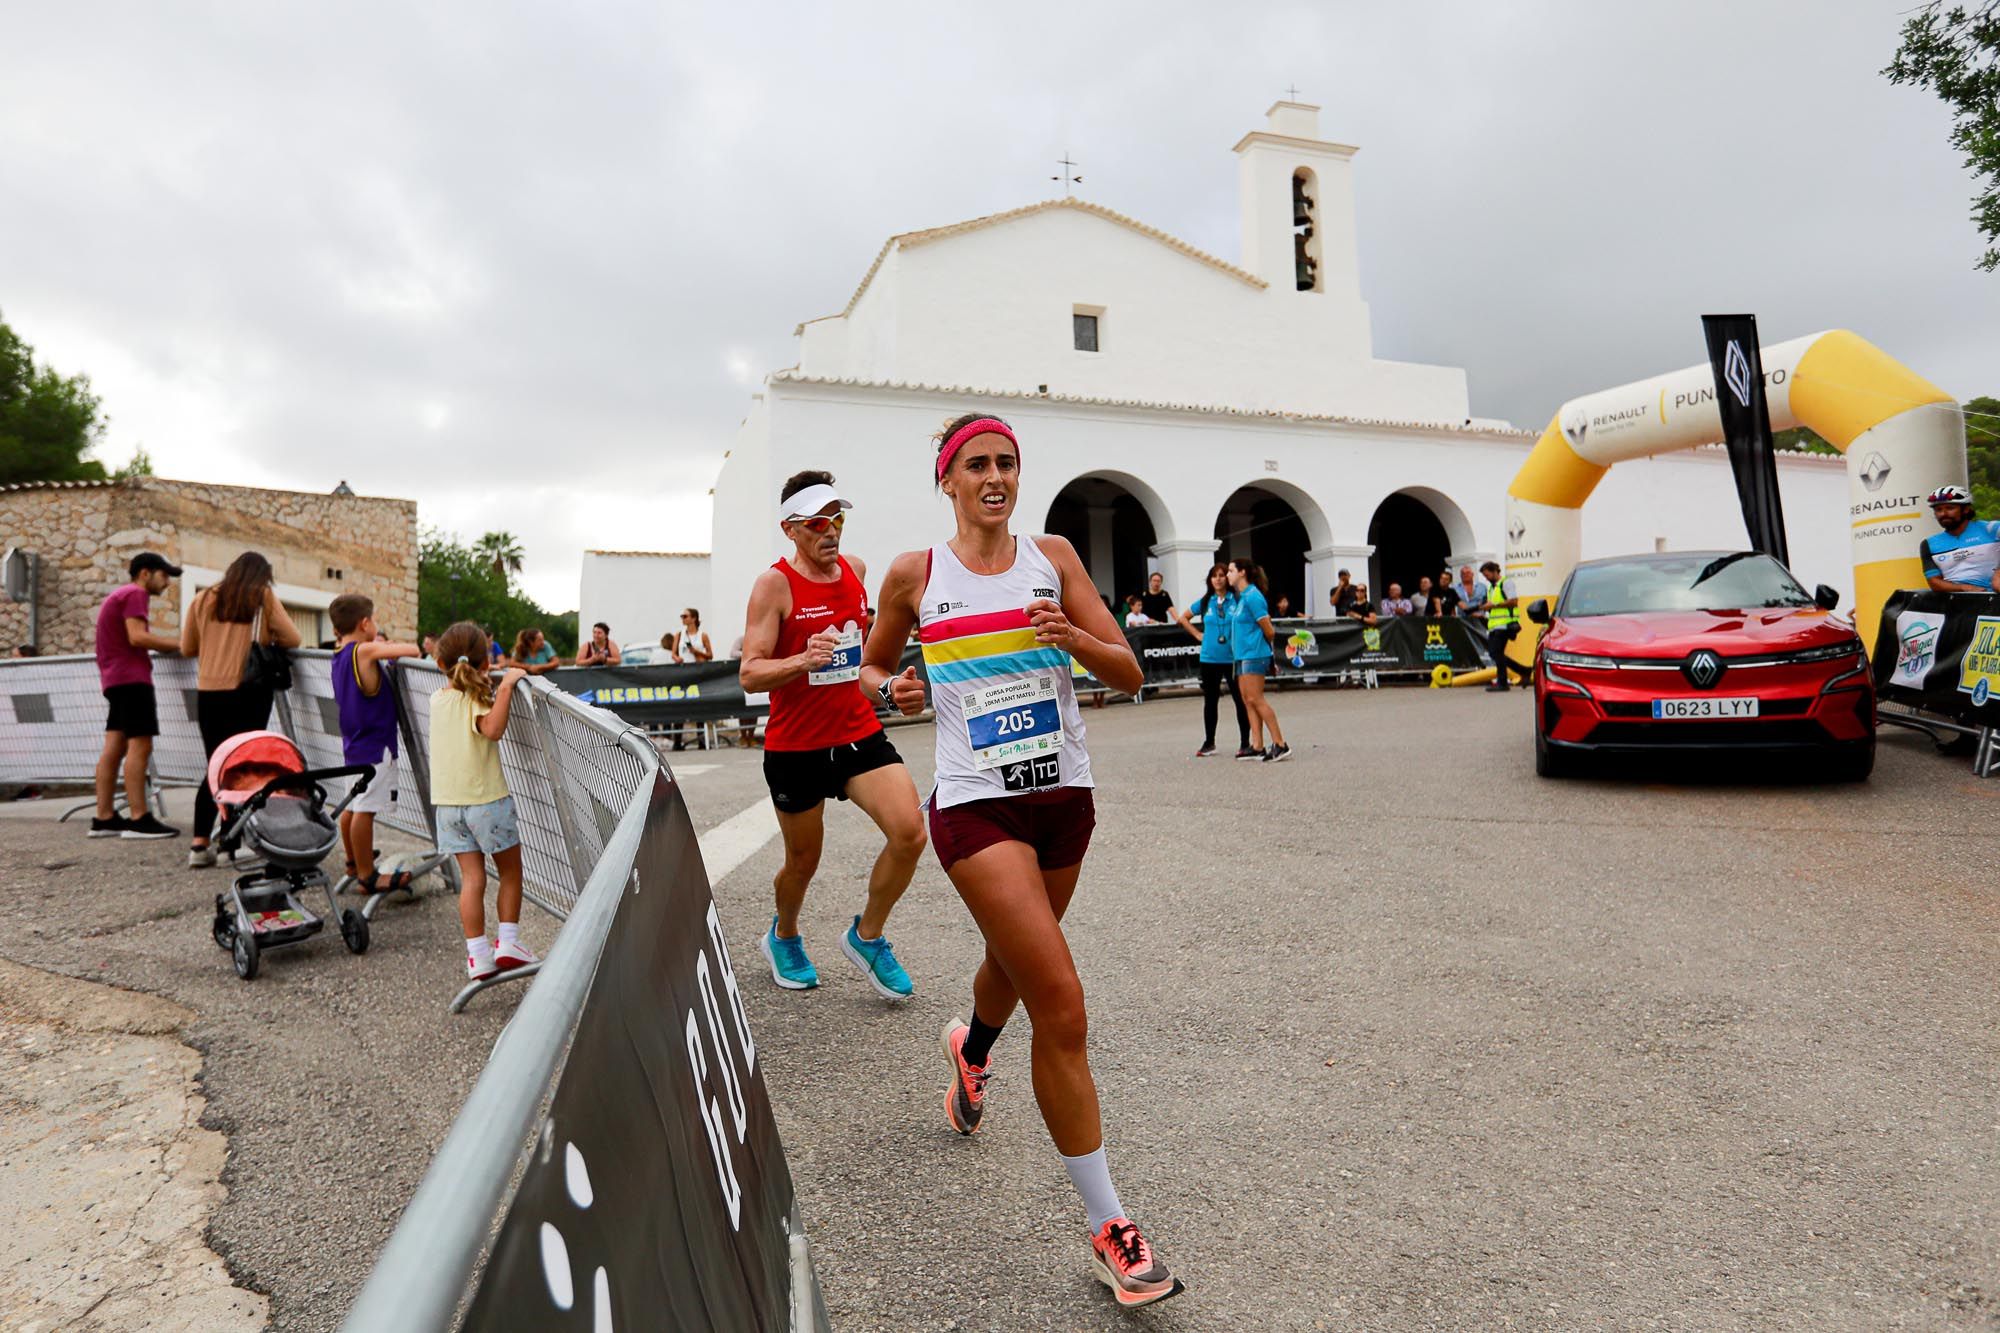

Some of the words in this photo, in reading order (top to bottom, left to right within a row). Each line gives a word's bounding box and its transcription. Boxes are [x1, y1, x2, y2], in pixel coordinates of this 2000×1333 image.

[1593, 405, 1648, 427] RENAULT
[985, 688, 1005, 698] CURSA
[1005, 682, 1031, 693] POPULAR
[984, 697, 1001, 707] 10KM
[1001, 694, 1016, 703] SANT
[1016, 691, 1036, 700] MATEU
[1665, 701, 1711, 716] 0623
[1718, 700, 1753, 715] LYY
[995, 709, 1035, 736] 205
[1035, 760, 1059, 779] TD
